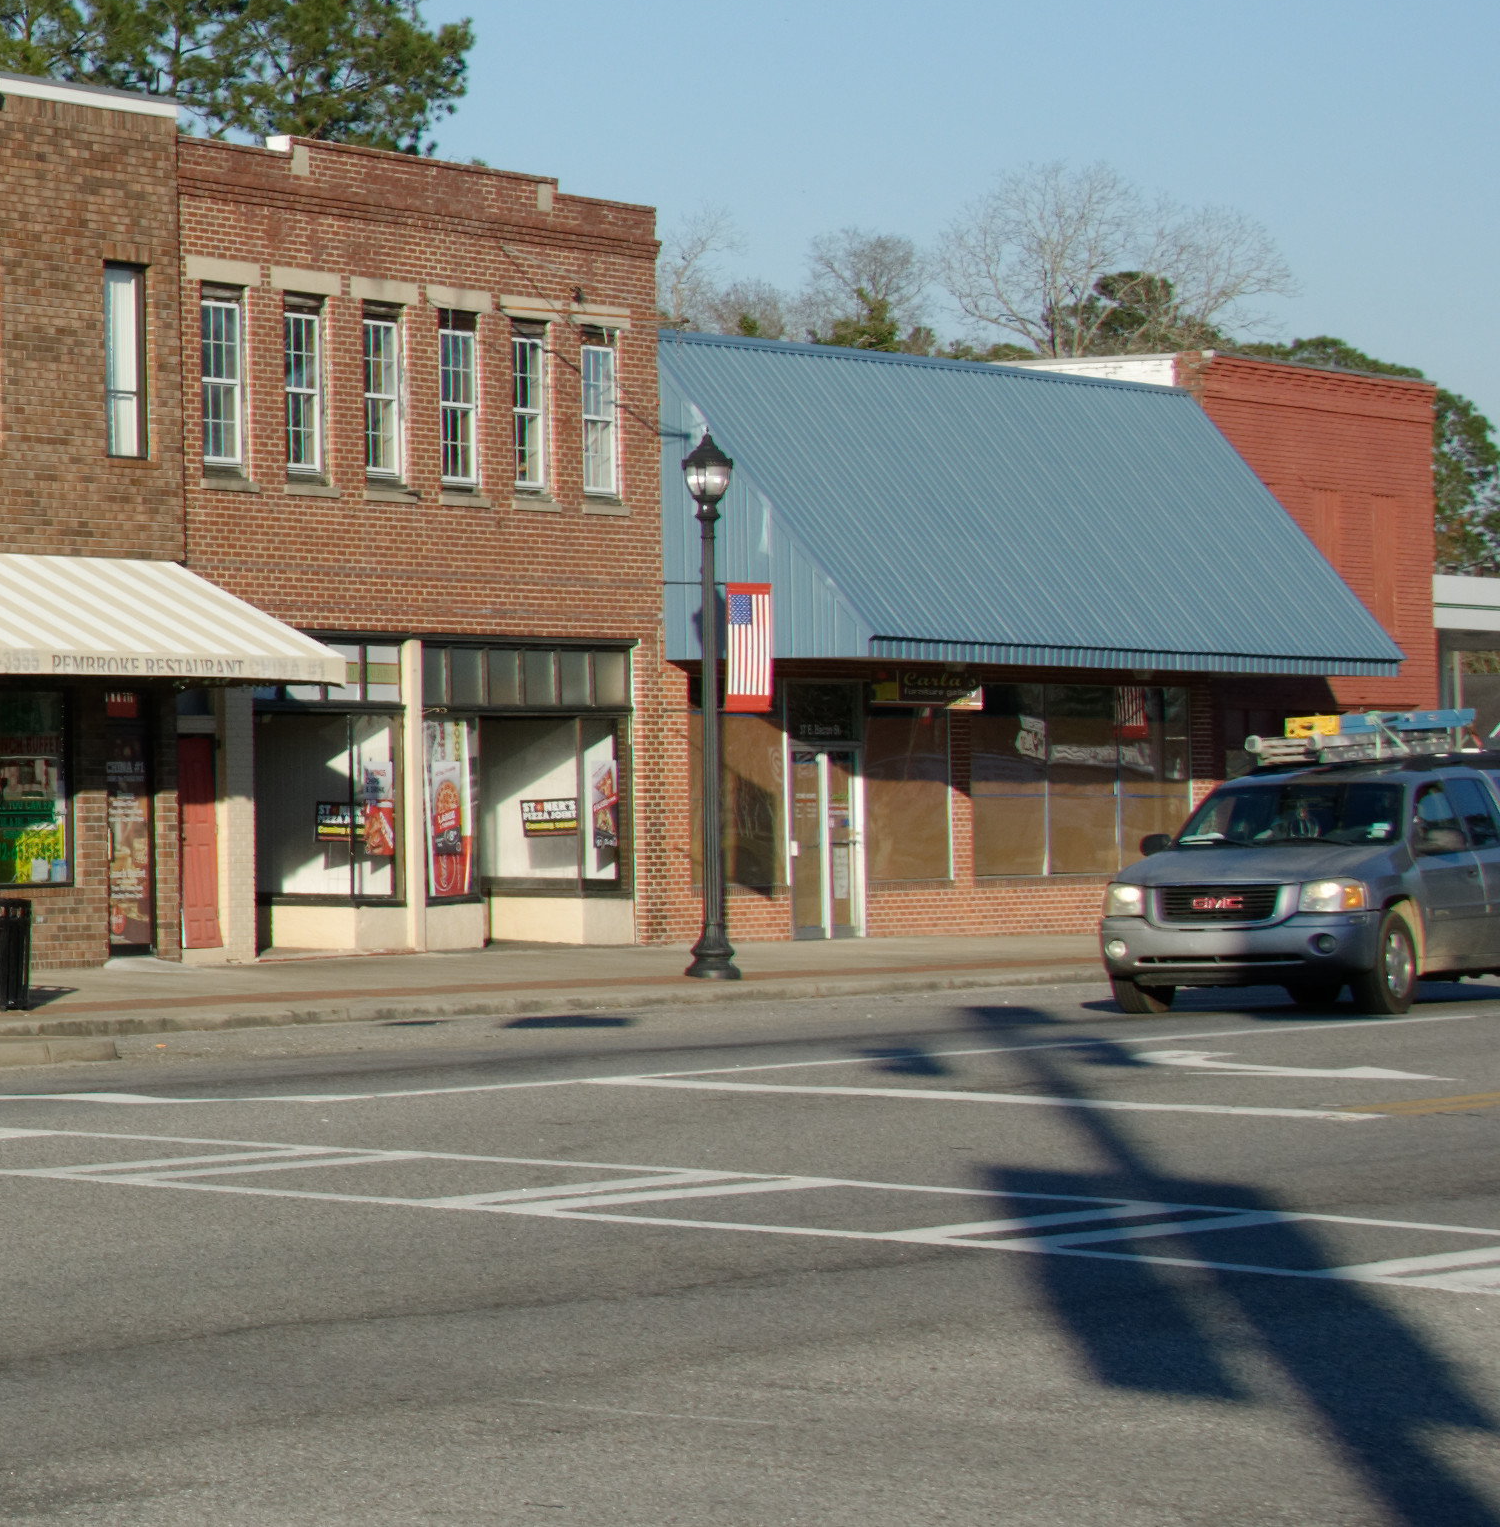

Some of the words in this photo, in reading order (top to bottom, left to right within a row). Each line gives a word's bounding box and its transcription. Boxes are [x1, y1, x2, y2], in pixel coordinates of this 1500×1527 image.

[51, 654, 140, 674] PEMBROKE
[145, 657, 245, 677] RESTAURANT
[1192, 896, 1244, 910] GMC
